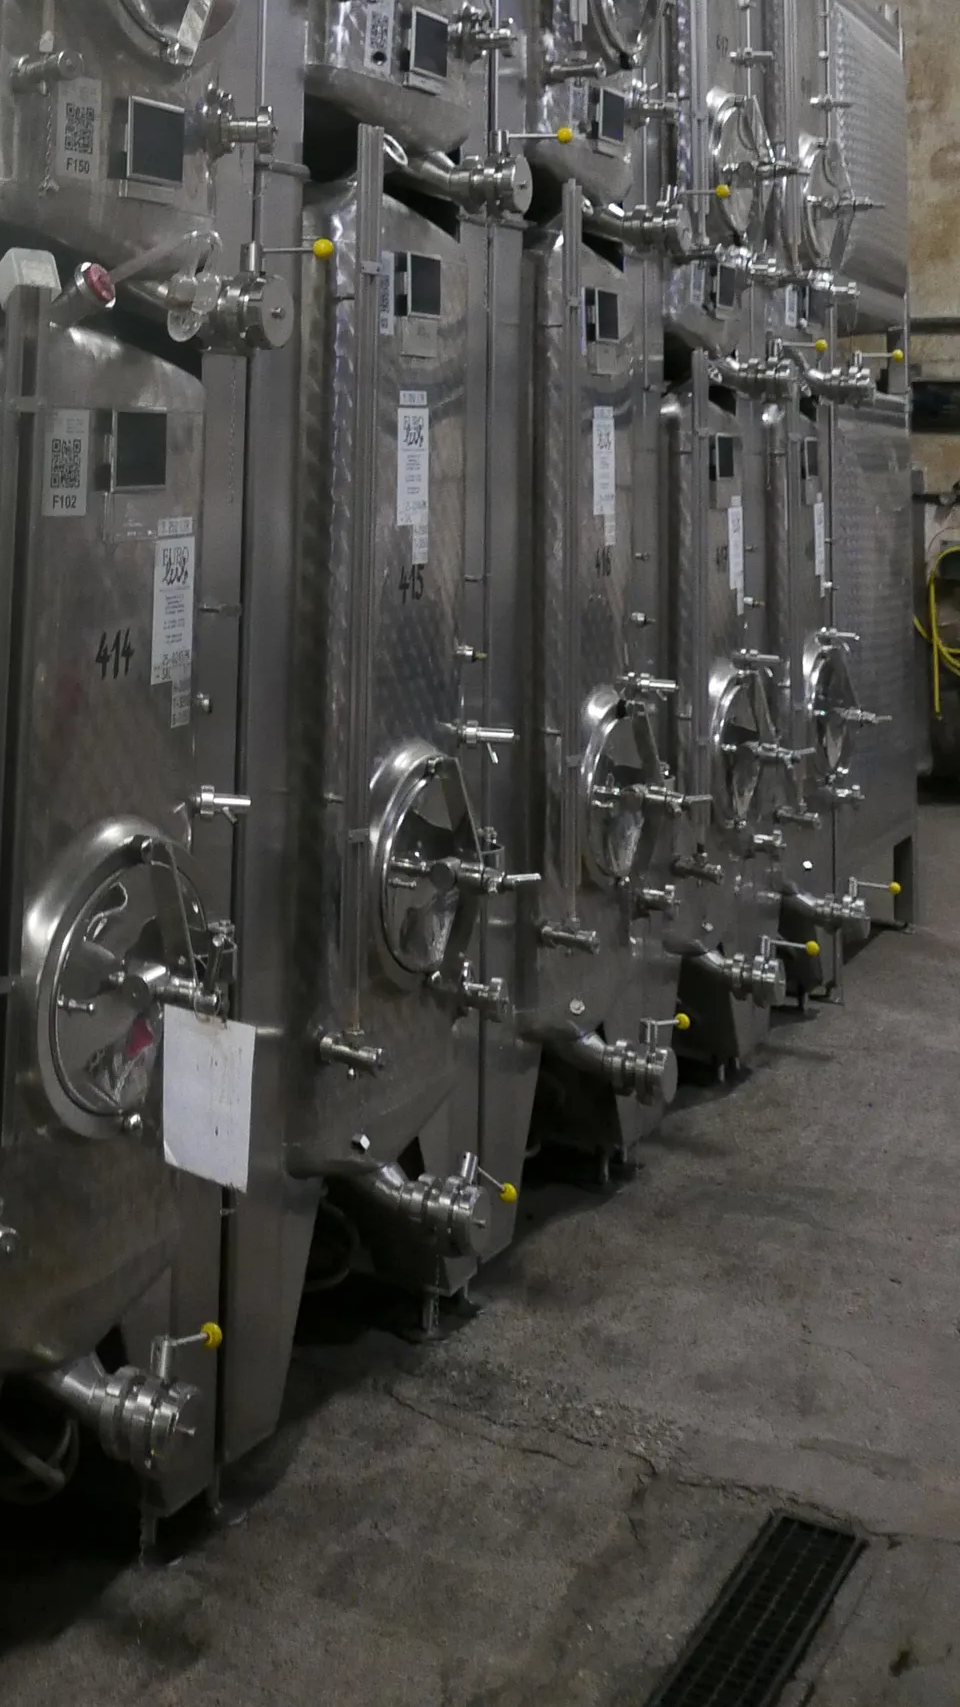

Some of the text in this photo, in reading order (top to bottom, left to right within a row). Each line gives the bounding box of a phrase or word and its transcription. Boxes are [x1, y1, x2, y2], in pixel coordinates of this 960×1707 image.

[52, 495, 77, 510] F102
[162, 545, 189, 567] EURO
[399, 564, 425, 606] 415
[95, 626, 135, 681] 414
